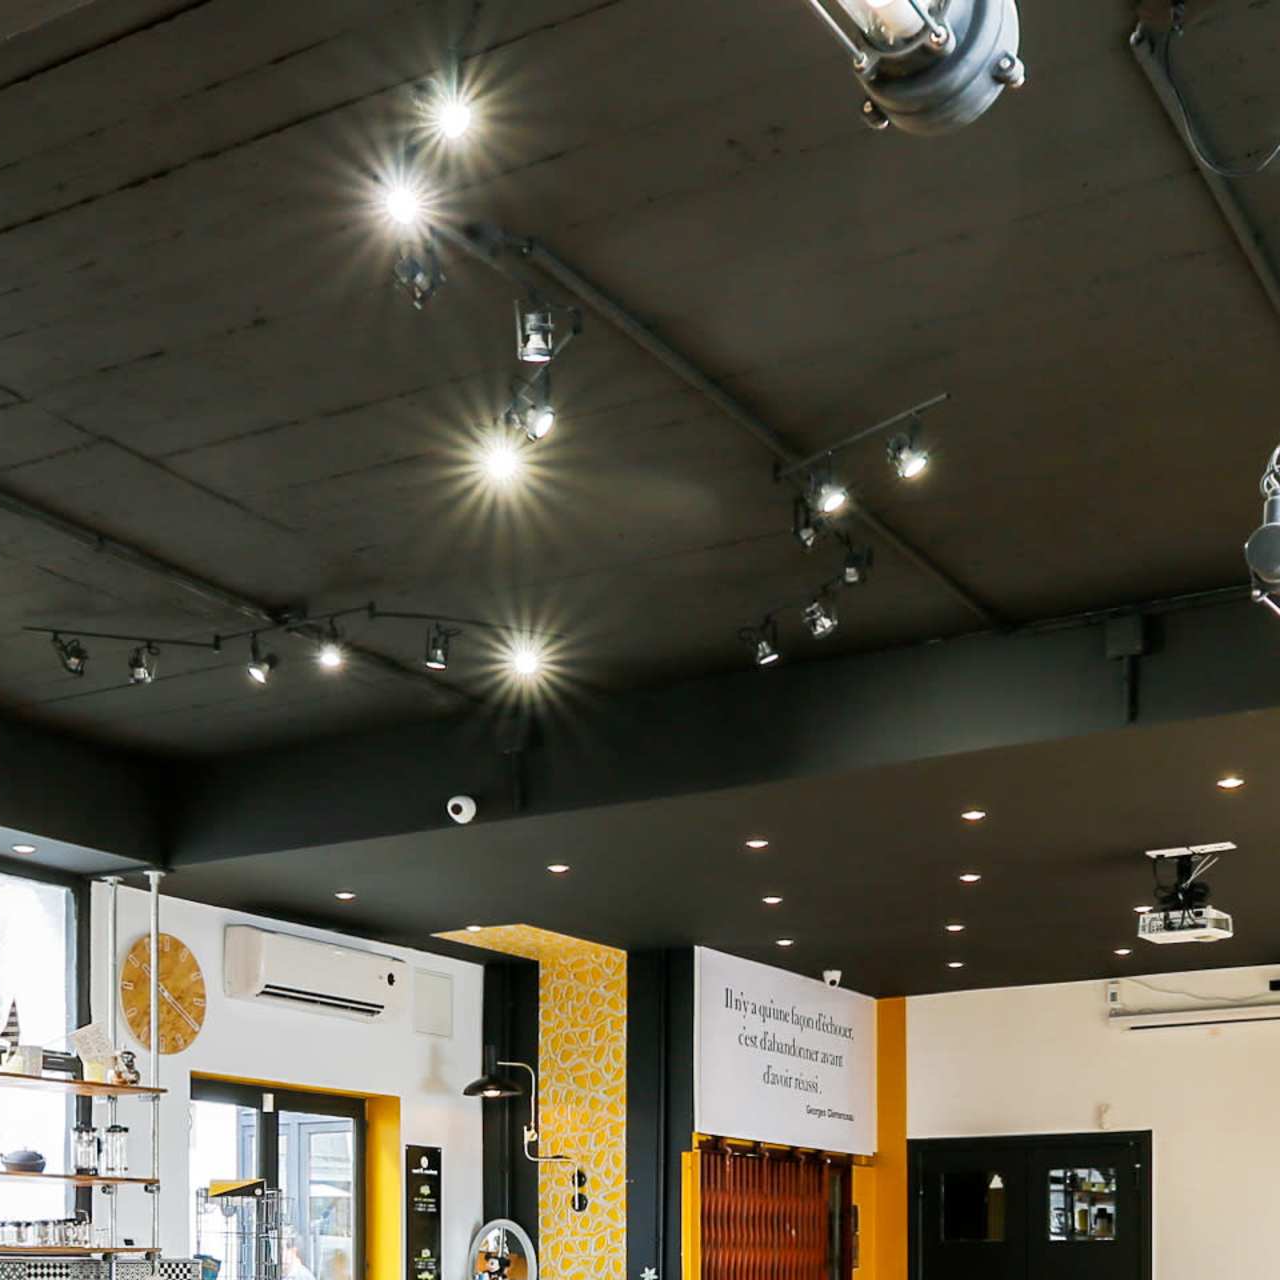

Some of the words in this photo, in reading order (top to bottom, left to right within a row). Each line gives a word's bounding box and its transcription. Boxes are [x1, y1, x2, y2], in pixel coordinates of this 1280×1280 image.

[724, 987, 733, 1009] Il
[751, 1002, 757, 1015] a
[758, 998, 790, 1024] qu'une
[791, 1005, 815, 1032] façon
[738, 1026, 759, 1049] c'est
[820, 1051, 844, 1068] avant
[762, 1064, 794, 1089] d'avoir
